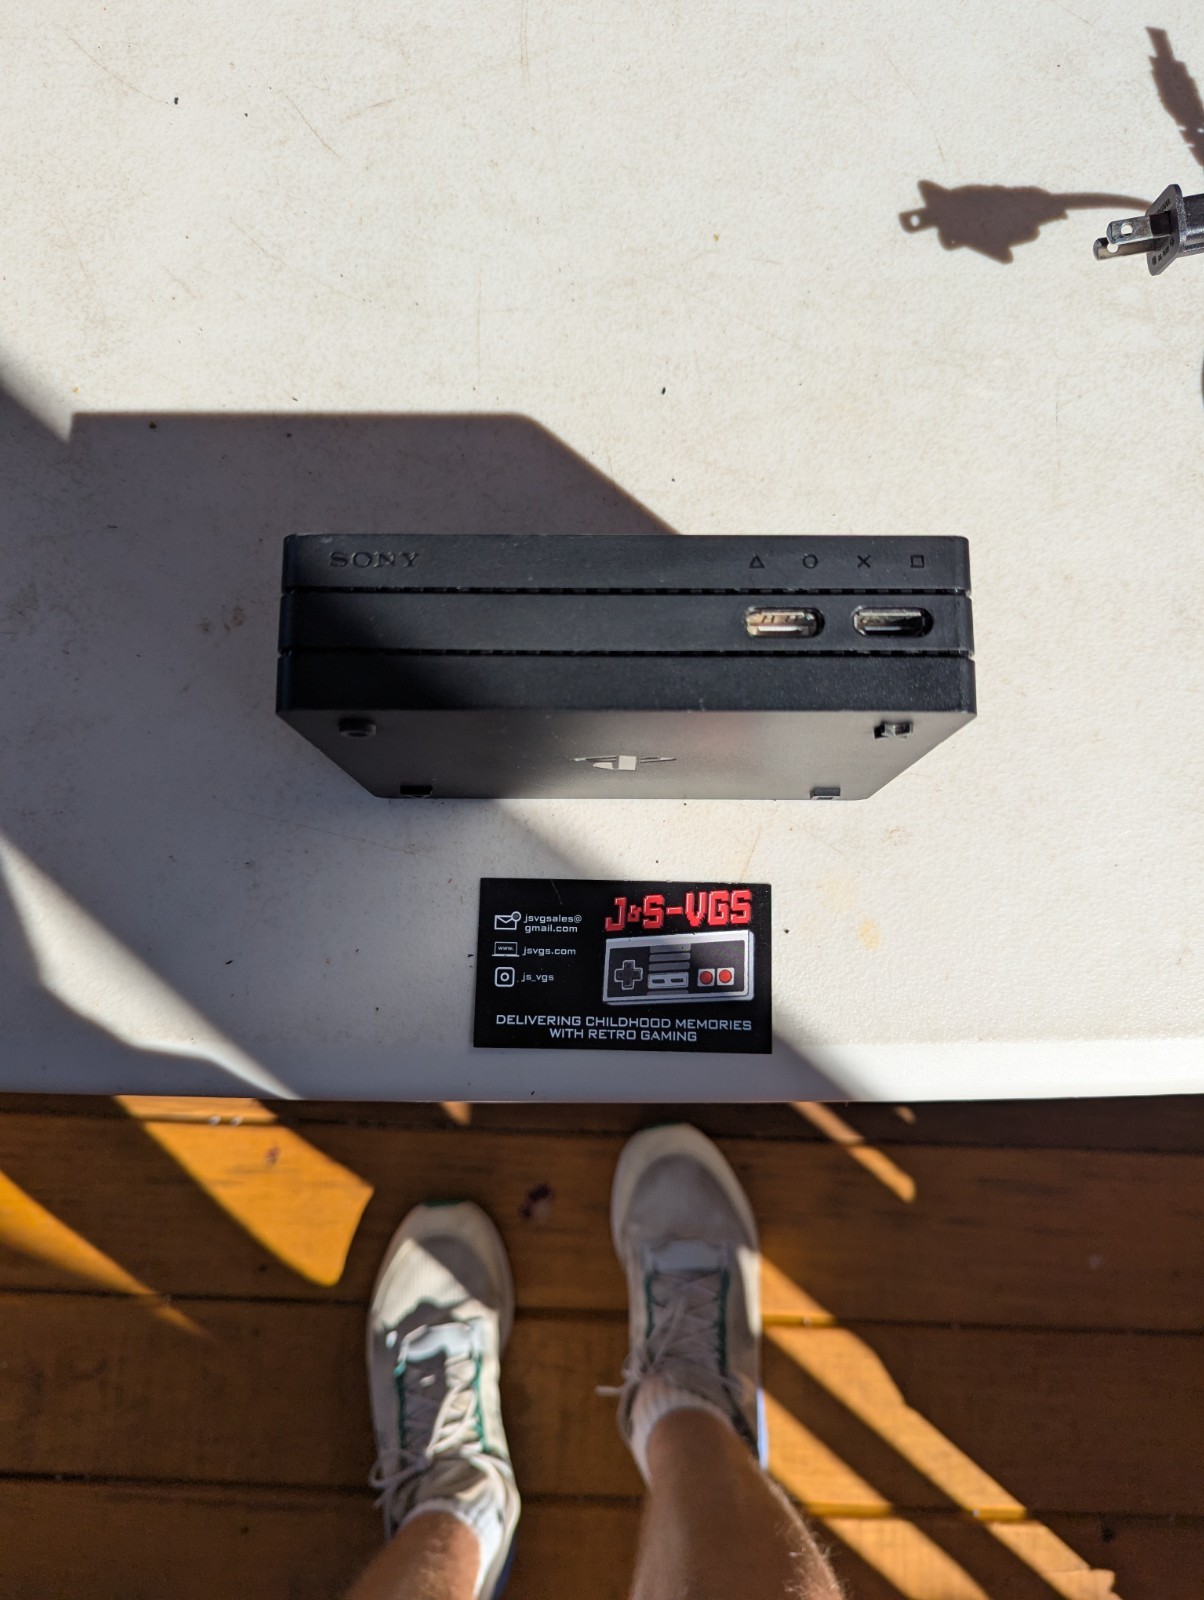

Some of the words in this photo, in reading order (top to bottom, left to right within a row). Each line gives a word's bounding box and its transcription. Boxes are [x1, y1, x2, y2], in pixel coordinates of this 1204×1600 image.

[329, 551, 420, 569] SONY
[523, 914, 583, 924] jsvgsales@
[524, 924, 579, 934] gmail.com
[522, 946, 577, 957] jsvgs.com
[521, 972, 555, 983] js_vgs
[495, 1014, 582, 1027] DELIVERING
[585, 1016, 672, 1028] CHILDHOOD
[675, 1019, 752, 1031] MEMORIES
[549, 1027, 584, 1040] WITH
[588, 1029, 637, 1040] RETRO
[640, 1031, 698, 1042] GAMING
